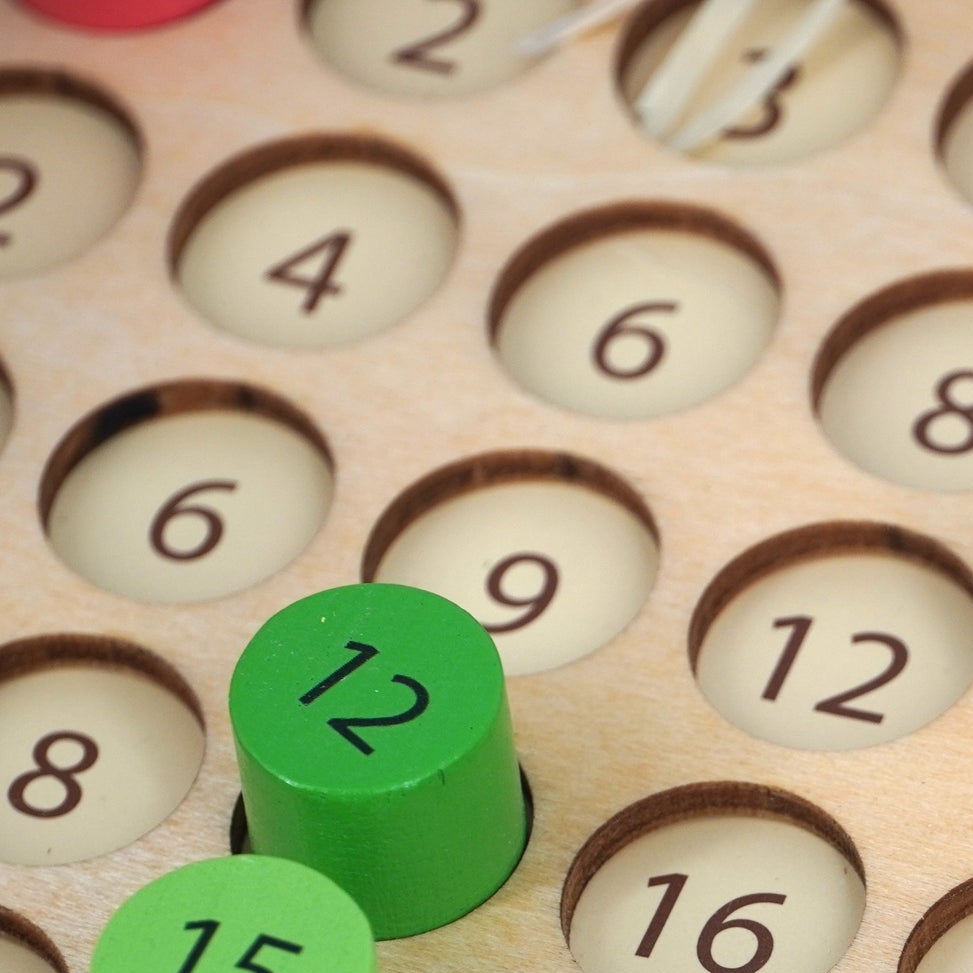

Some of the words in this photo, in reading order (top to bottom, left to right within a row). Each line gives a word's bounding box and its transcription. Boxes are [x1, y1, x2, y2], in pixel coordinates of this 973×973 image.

[391, 0, 485, 76] 2
[265, 228, 352, 316] 4
[591, 301, 680, 380] 6
[149, 479, 240, 562] 6
[483, 552, 559, 634] 9
[299, 641, 430, 756] 12
[760, 615, 910, 725] 12
[7, 730, 100, 819] 8
